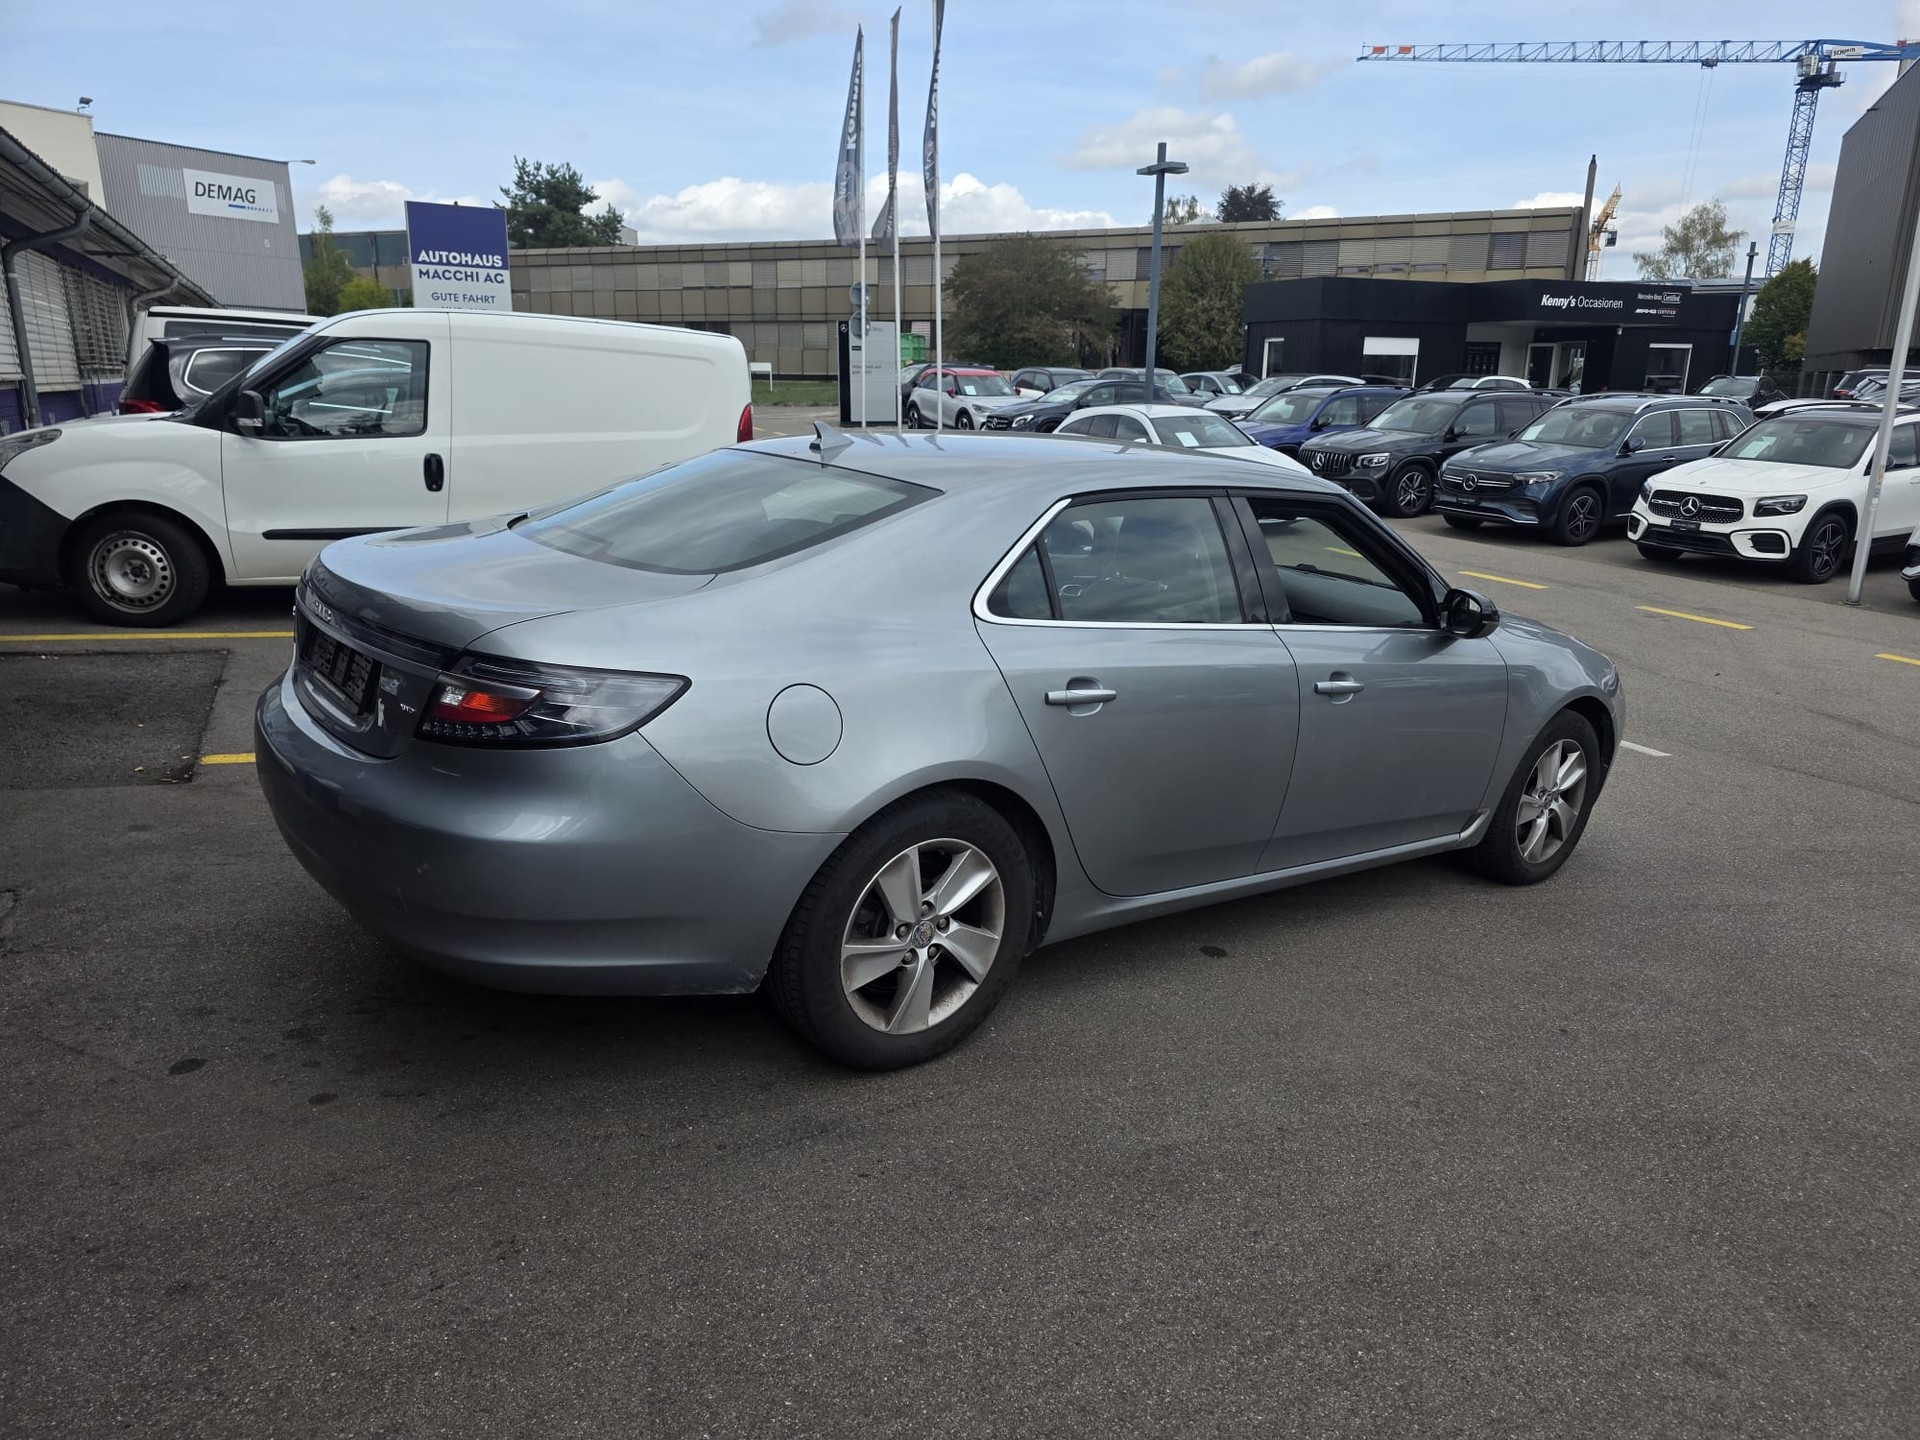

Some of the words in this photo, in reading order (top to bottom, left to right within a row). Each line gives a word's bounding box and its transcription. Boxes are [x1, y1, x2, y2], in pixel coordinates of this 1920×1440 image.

[195, 181, 256, 204] DEMAG
[419, 249, 502, 267] AUTOHAUS
[418, 268, 479, 282] MACCHI
[483, 272, 505, 284] AG
[431, 292, 460, 303] GUTE
[462, 293, 496, 304] FAHRT
[1541, 294, 1576, 309] Kenny's
[1577, 296, 1624, 309] Occasionen
